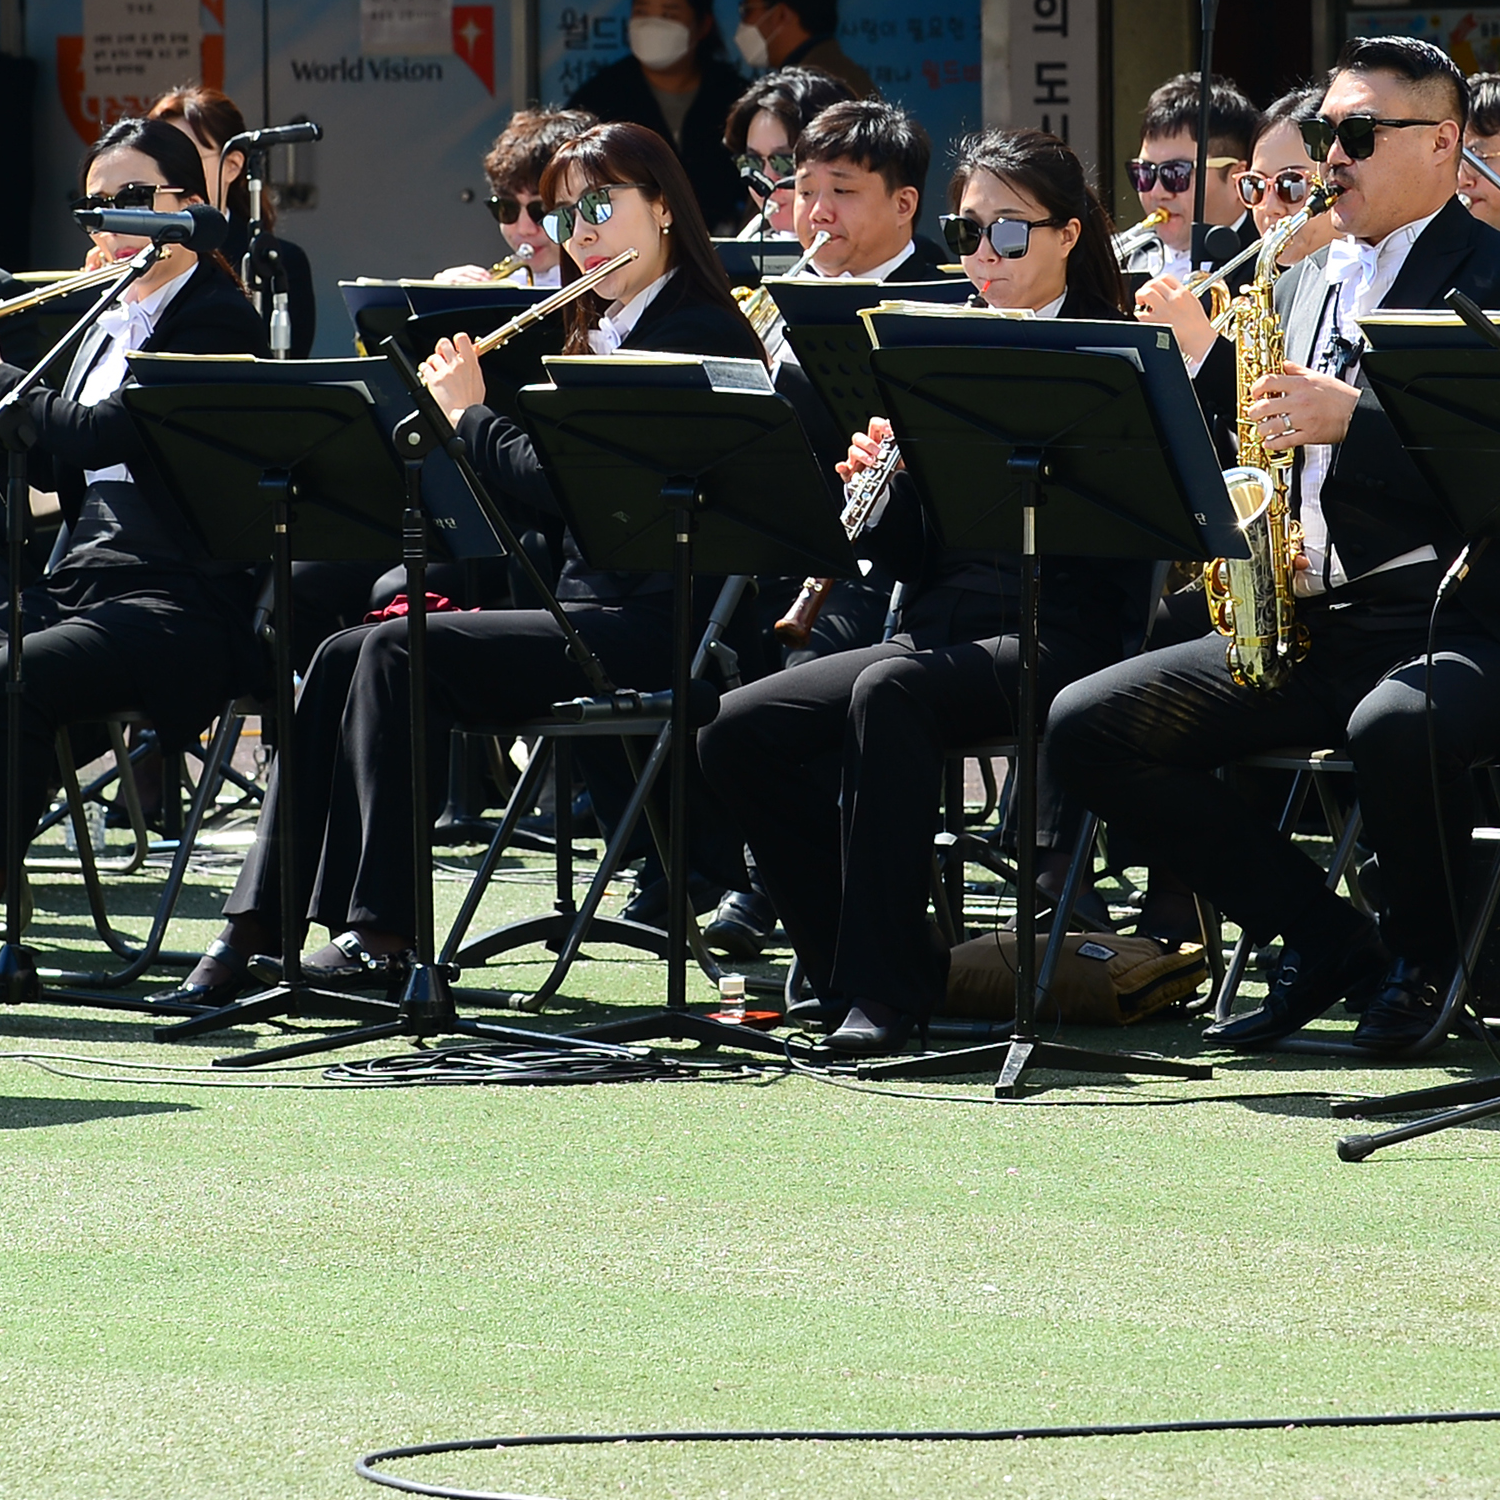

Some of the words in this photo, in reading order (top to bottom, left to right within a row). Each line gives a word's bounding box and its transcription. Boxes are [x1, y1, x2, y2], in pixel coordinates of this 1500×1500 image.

[556, 7, 630, 50] 월드
[291, 57, 364, 83] World
[366, 56, 443, 82] Vision
